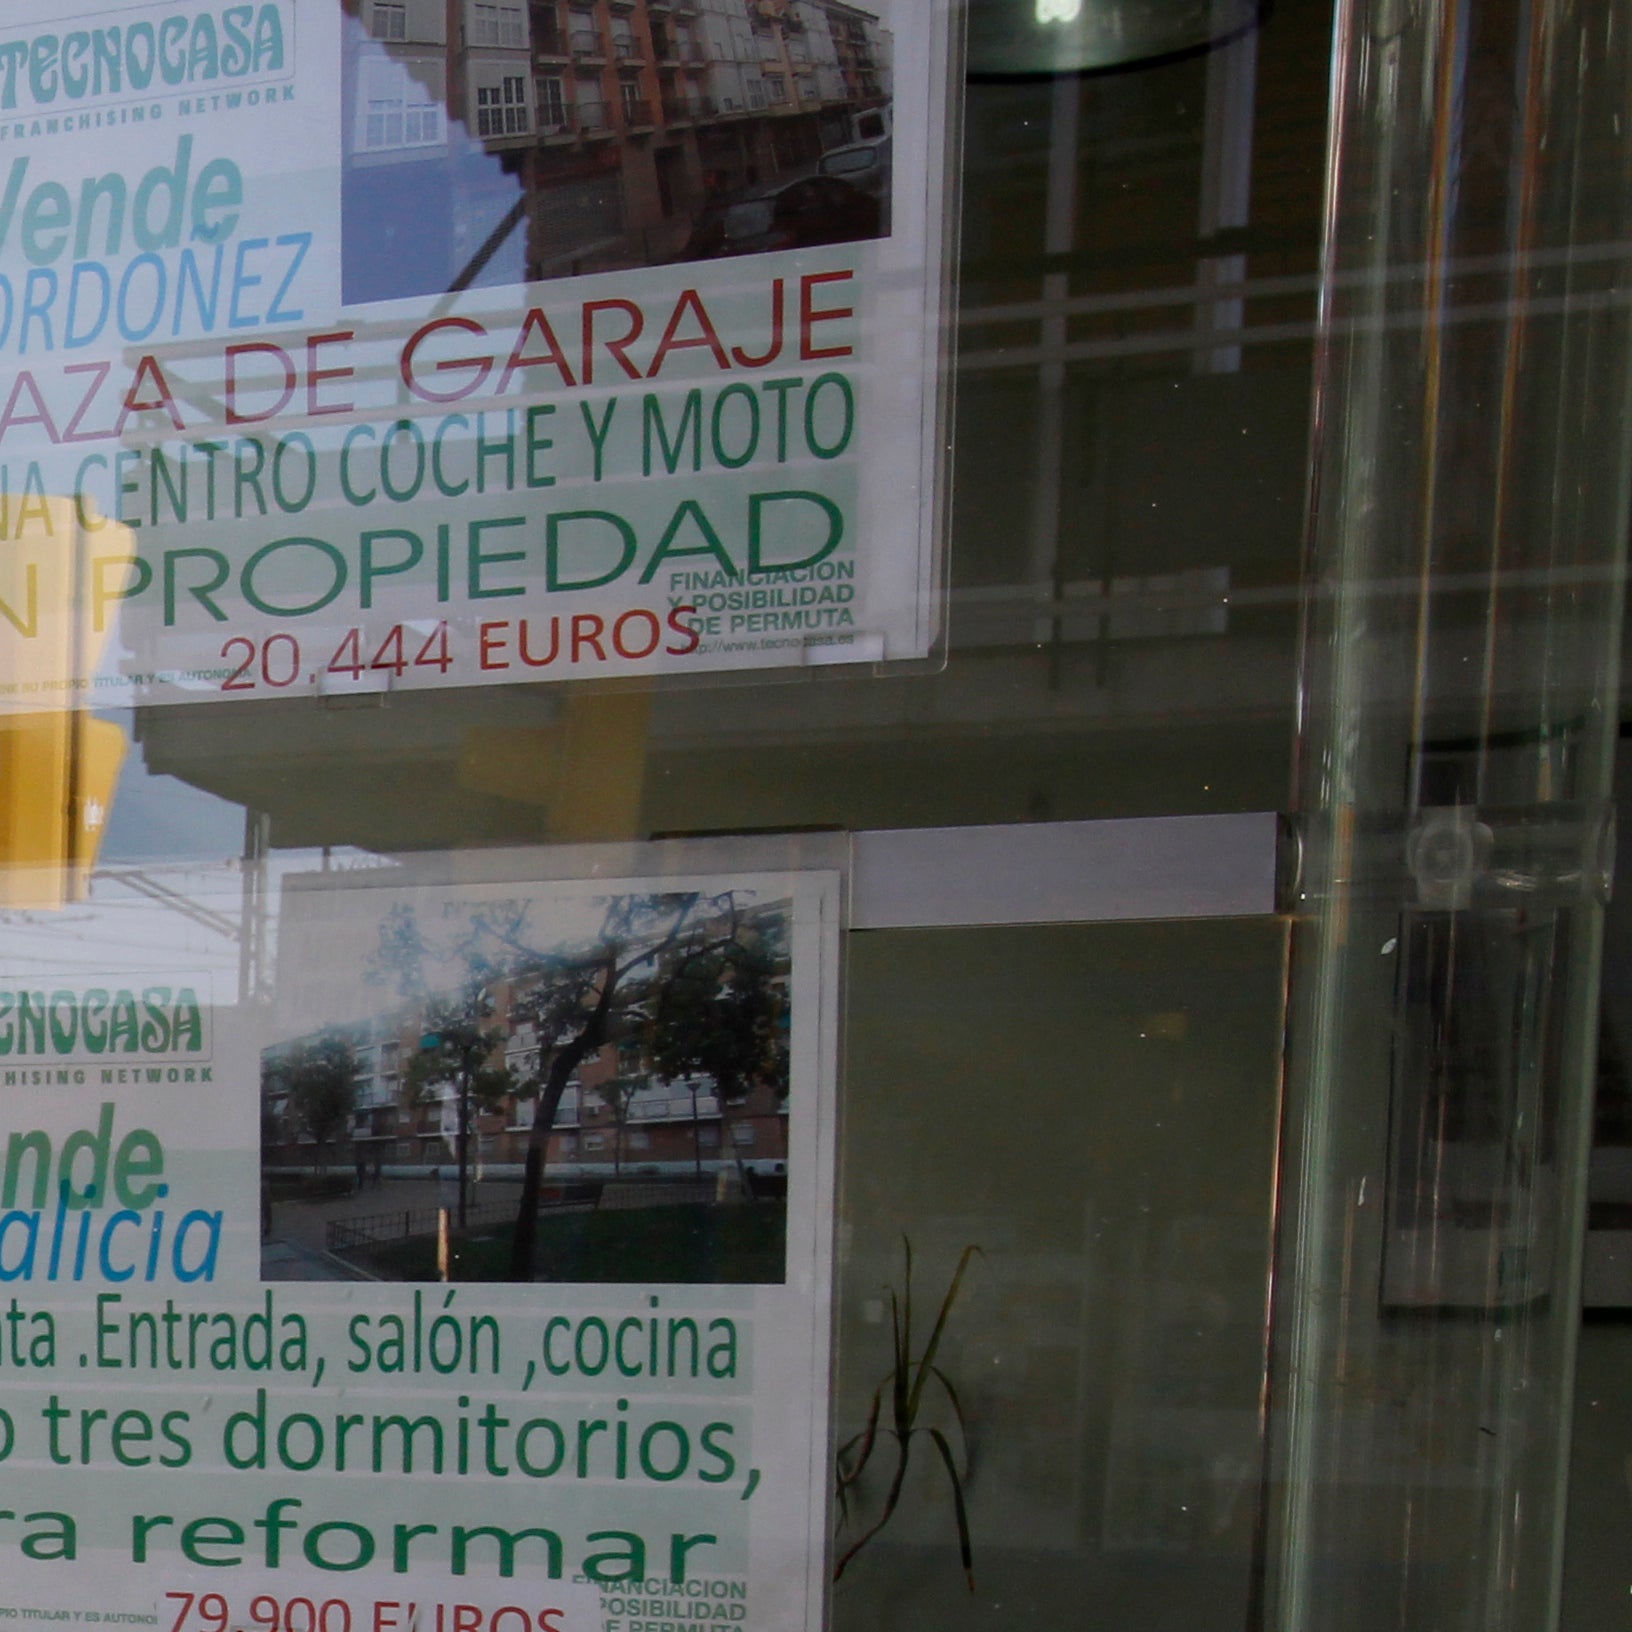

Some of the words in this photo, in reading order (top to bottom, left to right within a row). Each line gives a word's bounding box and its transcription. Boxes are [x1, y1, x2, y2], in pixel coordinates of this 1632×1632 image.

[226, 332, 354, 424] DE
[401, 271, 854, 400] GARAJE
[75, 439, 315, 532] CENTRO
[340, 407, 554, 504] COCHE
[581, 401, 619, 476] Y
[642, 372, 854, 472] MOTO
[93, 490, 844, 632] PROPIEDAD
[670, 560, 855, 592] FINANCIACION
[692, 584, 855, 612] POSIBILIDAD
[221, 619, 453, 690] 20.444
[481, 607, 700, 671] EUROS
[731, 608, 855, 634] PERMUTA
[101, 1067, 213, 1083] NETWORK
[348, 1289, 501, 1377] salón
[43, 1402, 192, 1467] tres
[224, 1387, 760, 1500] dormitorios,
[134, 1496, 716, 1582] reformar
[22, 1609, 70, 1621] TITULAR
[74, 1611, 81, 1621] Y
[85, 1612, 99, 1622] ES
